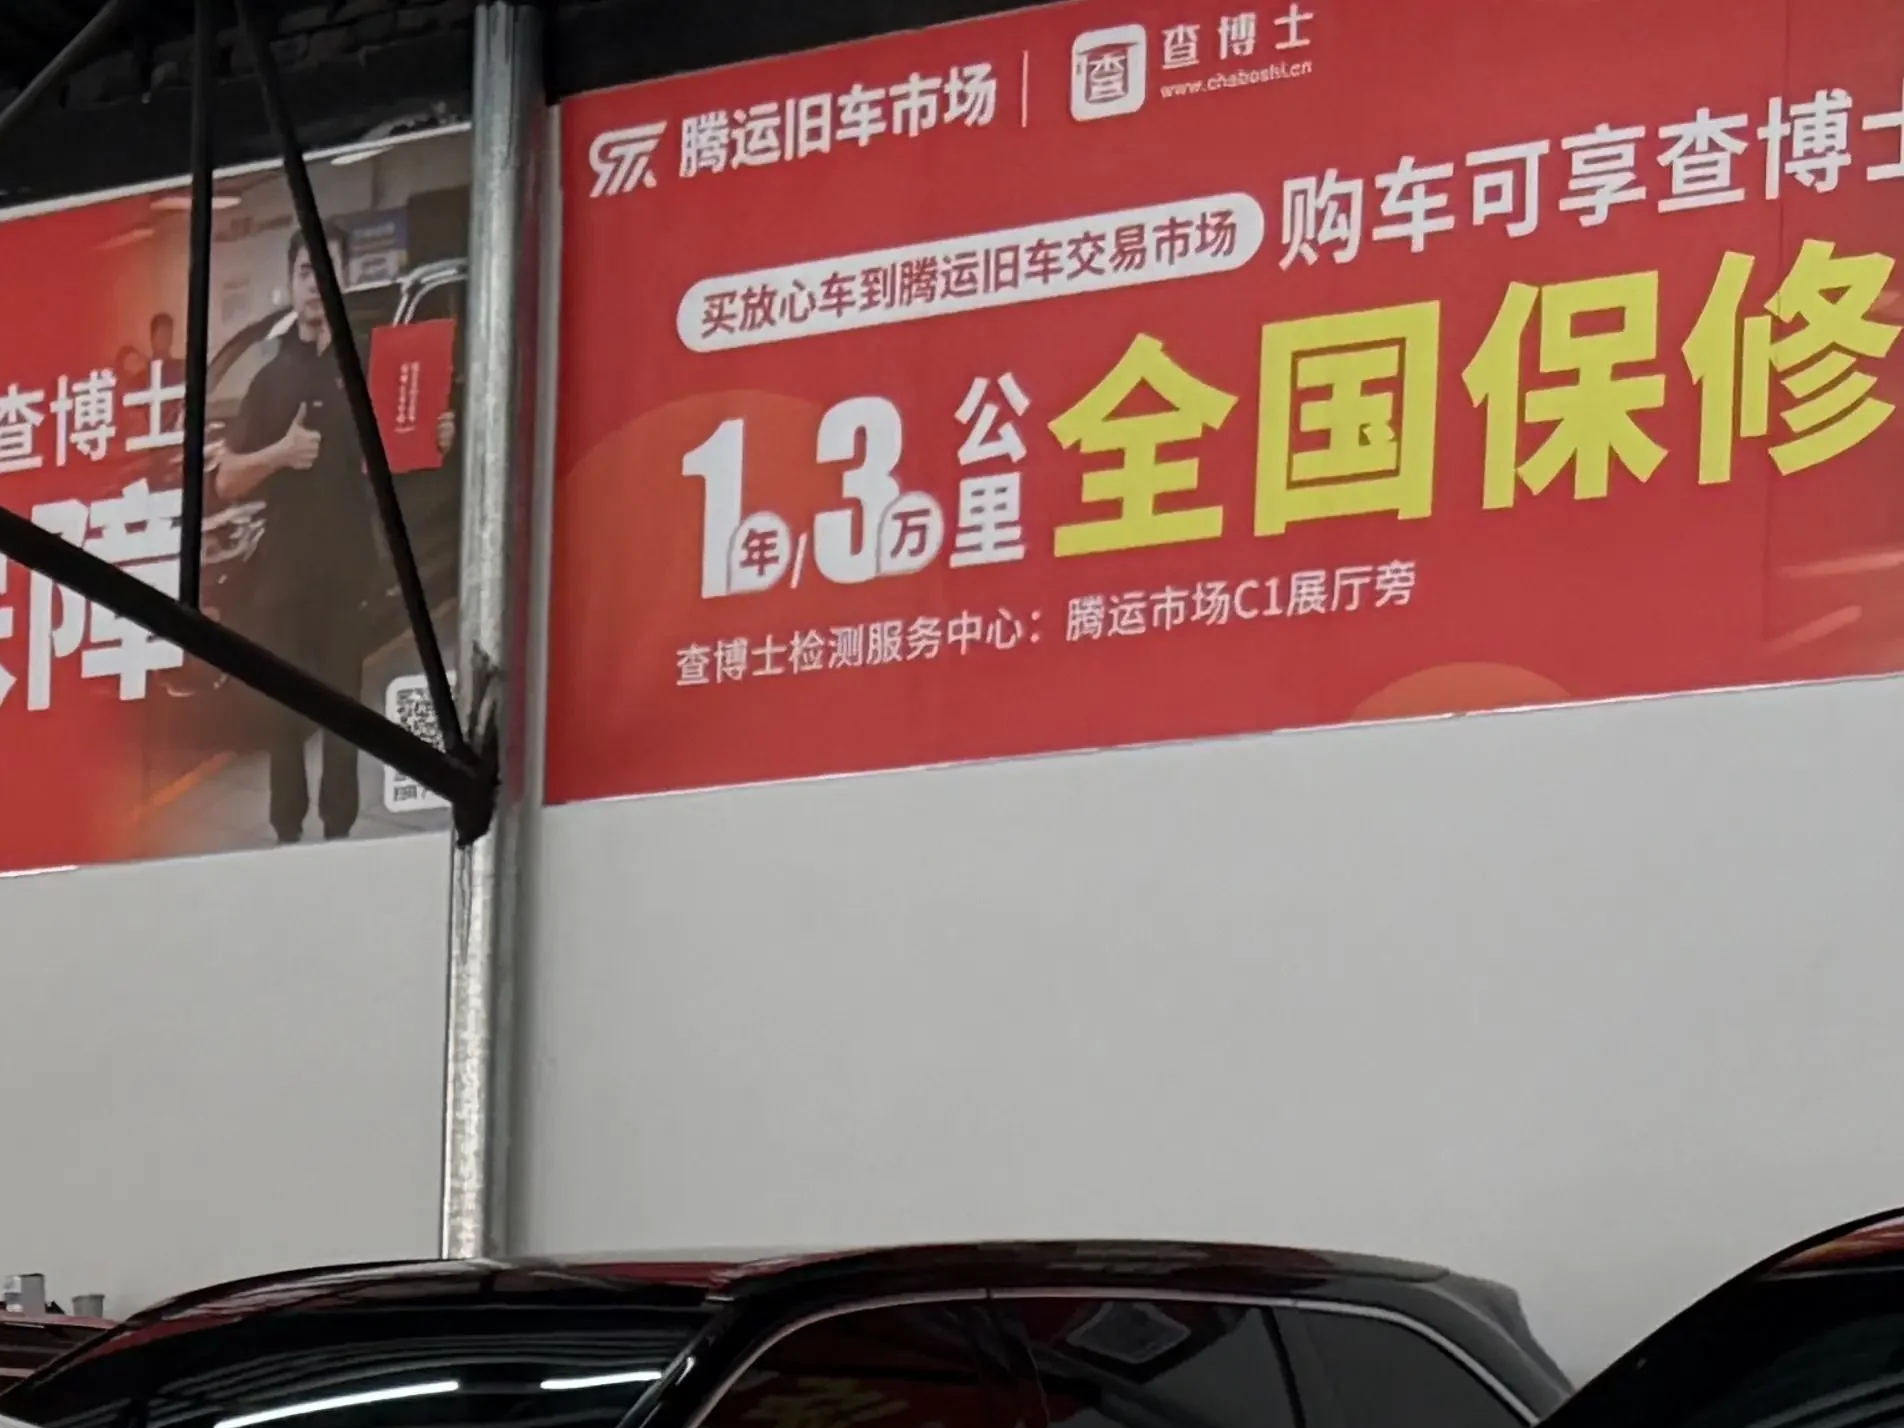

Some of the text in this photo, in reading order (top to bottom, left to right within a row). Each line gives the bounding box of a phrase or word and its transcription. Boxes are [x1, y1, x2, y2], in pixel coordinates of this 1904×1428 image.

[1161, 3, 1314, 70] 查博士
[678, 62, 998, 178] 腾运旧车市场
[700, 210, 1238, 338] 买放心车到腾运旧车交易市场
[1047, 239, 1902, 557] 全国保修
